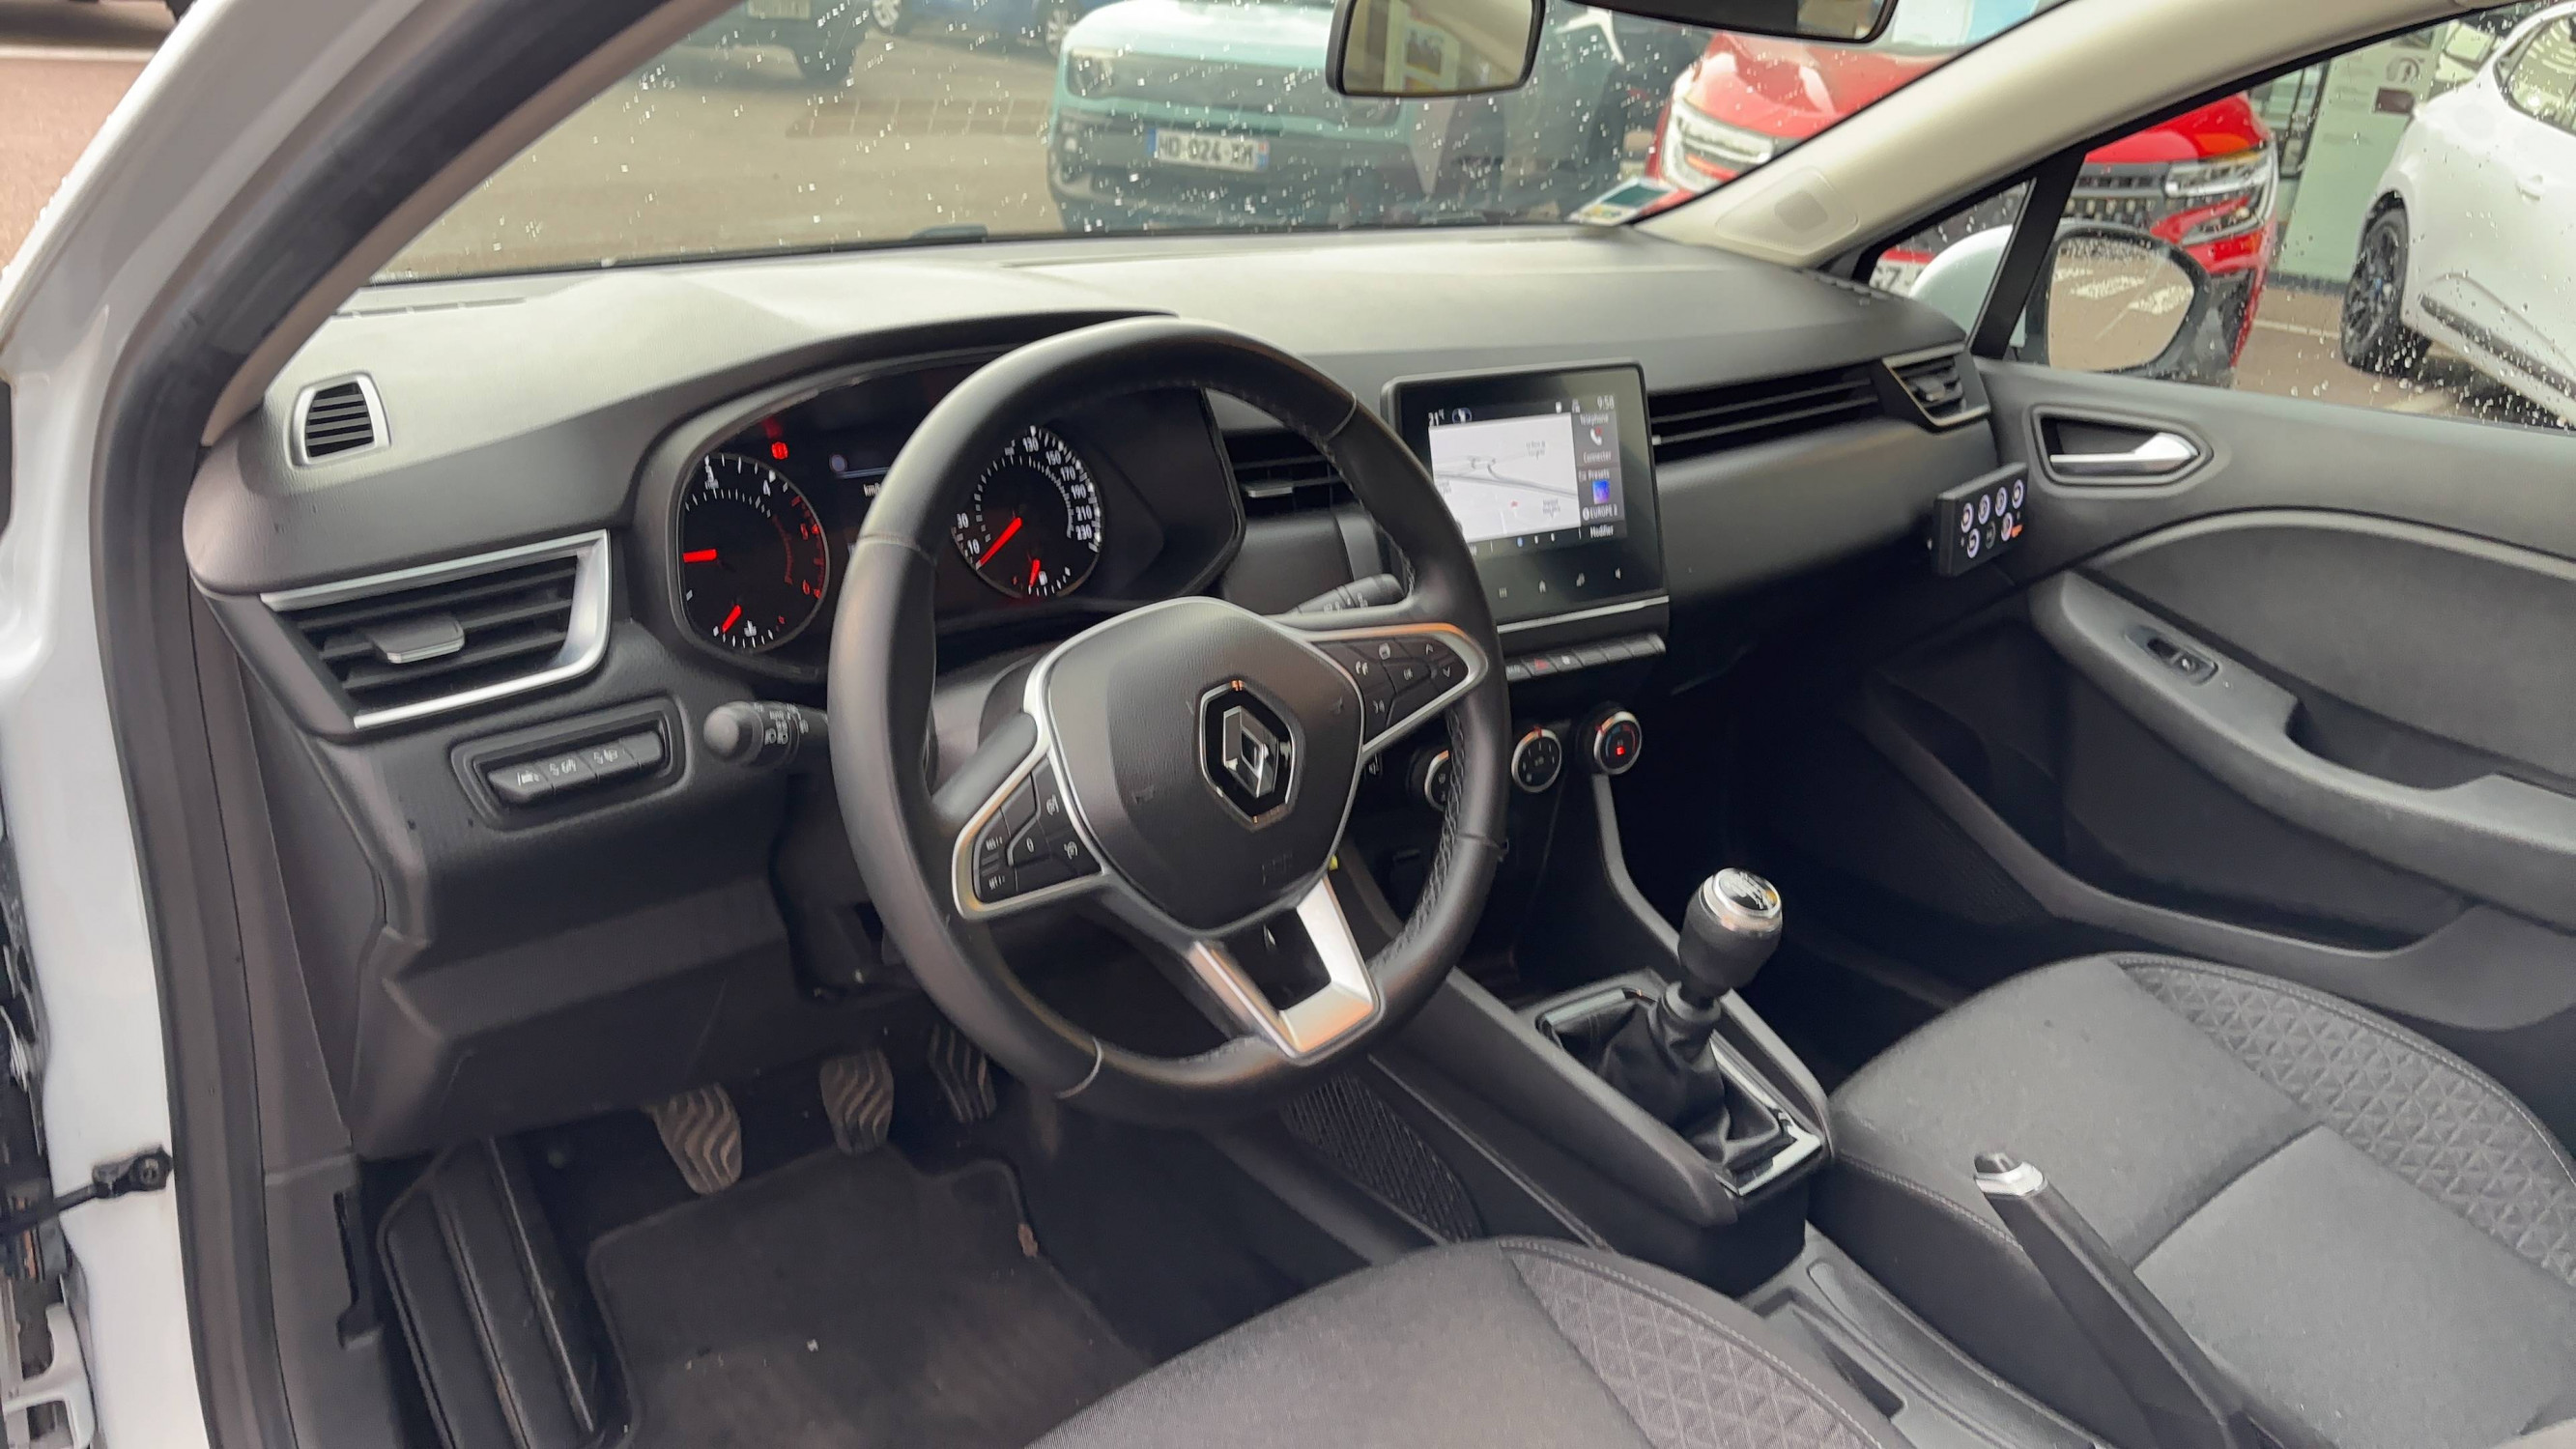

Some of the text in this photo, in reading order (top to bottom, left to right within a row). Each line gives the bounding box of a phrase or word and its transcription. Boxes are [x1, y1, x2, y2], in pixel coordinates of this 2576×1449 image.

[1022, 437, 1039, 452] 130
[1045, 450, 1062, 466] 150
[1060, 466, 1075, 481] 170
[1071, 483, 1086, 499] 190
[1075, 505, 1092, 522] 210
[1076, 524, 1093, 541] 230
[968, 538, 980, 554] 10
